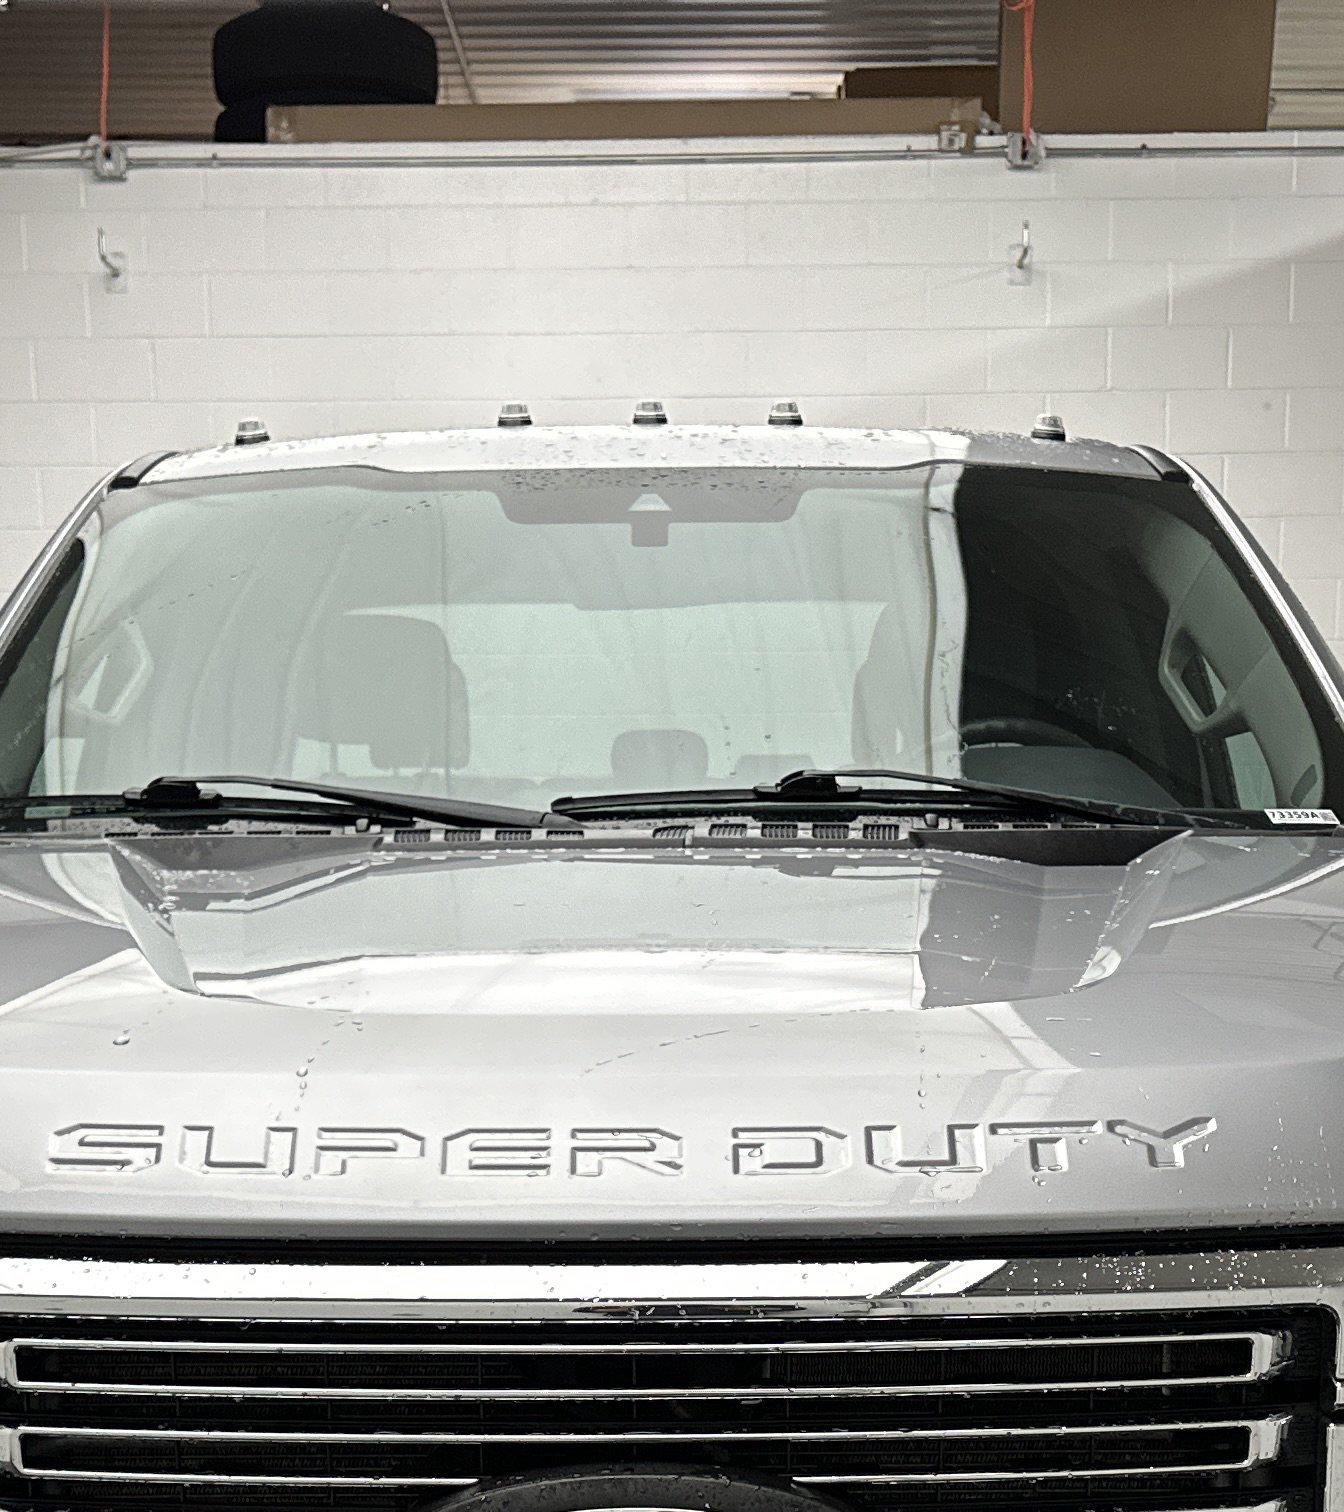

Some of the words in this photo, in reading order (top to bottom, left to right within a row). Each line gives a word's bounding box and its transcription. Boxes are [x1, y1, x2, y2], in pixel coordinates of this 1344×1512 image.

[1268, 811, 1321, 819] 73359A
[45, 1121, 684, 1177] SUPER
[731, 1115, 1218, 1175] DUTY
